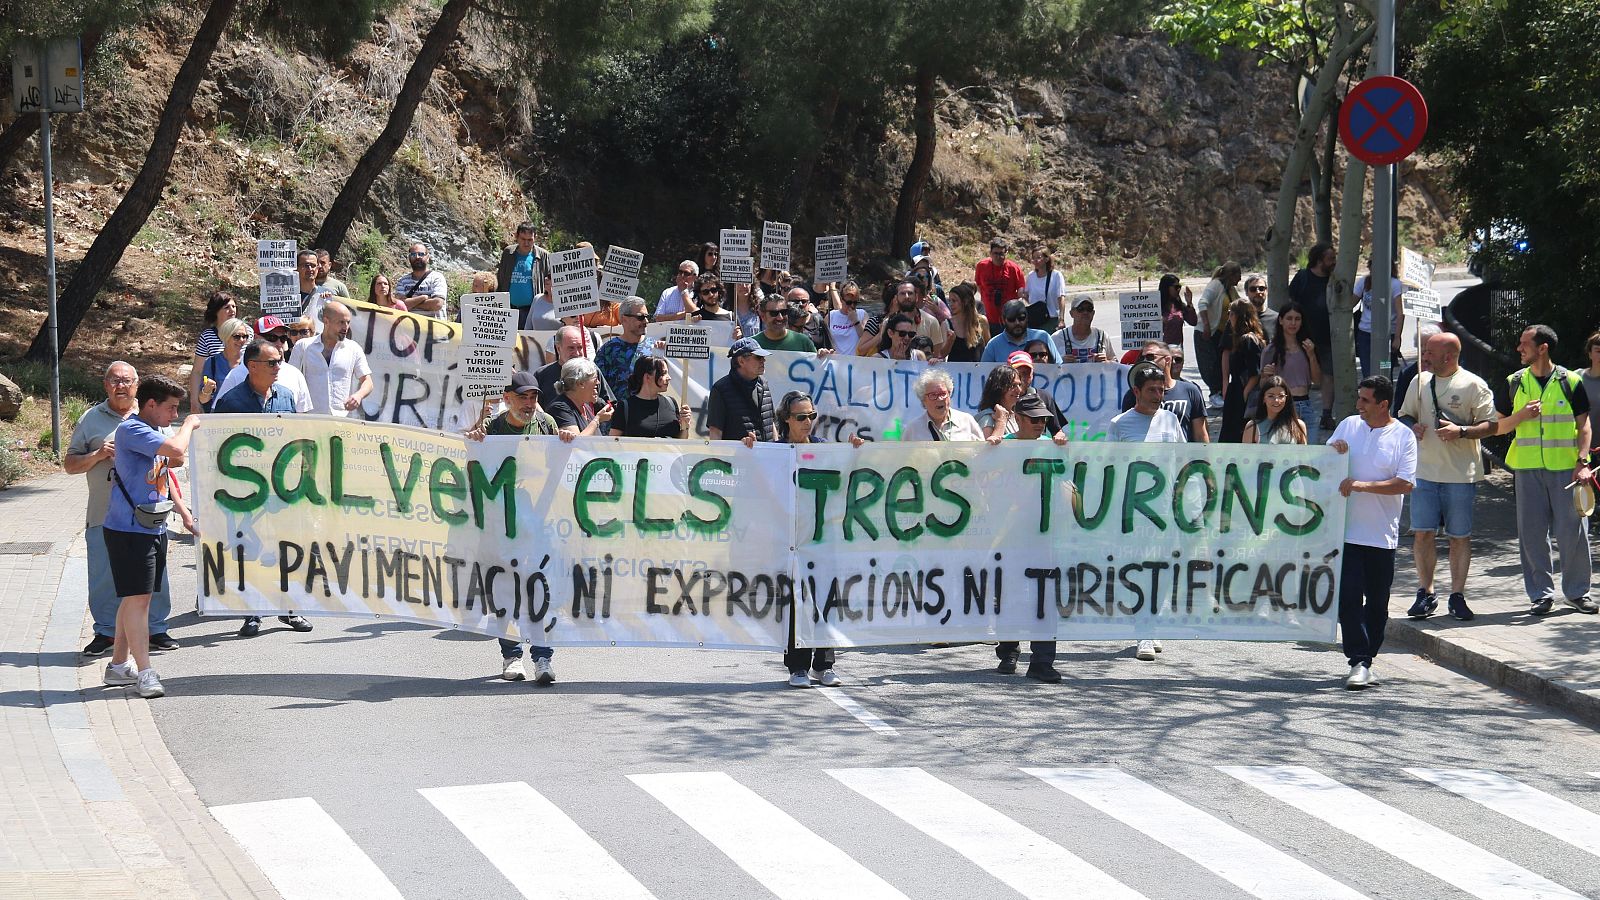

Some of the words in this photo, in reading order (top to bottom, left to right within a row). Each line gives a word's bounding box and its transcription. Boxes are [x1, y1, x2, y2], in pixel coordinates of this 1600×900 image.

[260, 250, 295, 258] IMPUNITAT
[563, 251, 580, 261] STOP
[553, 259, 593, 273] IMPUNITAT
[565, 270, 594, 281] TURISTES
[606, 282, 631, 291] TURISME
[569, 293, 591, 302] TOMBA
[473, 327, 508, 335] D'AQUEST
[1123, 331, 1161, 339] IMPUNITAT
[474, 333, 506, 341] TURISME
[669, 336, 707, 345] ALCEM-NOS!
[788, 358, 919, 411] SALUT
[1023, 458, 1324, 536] TURONS
